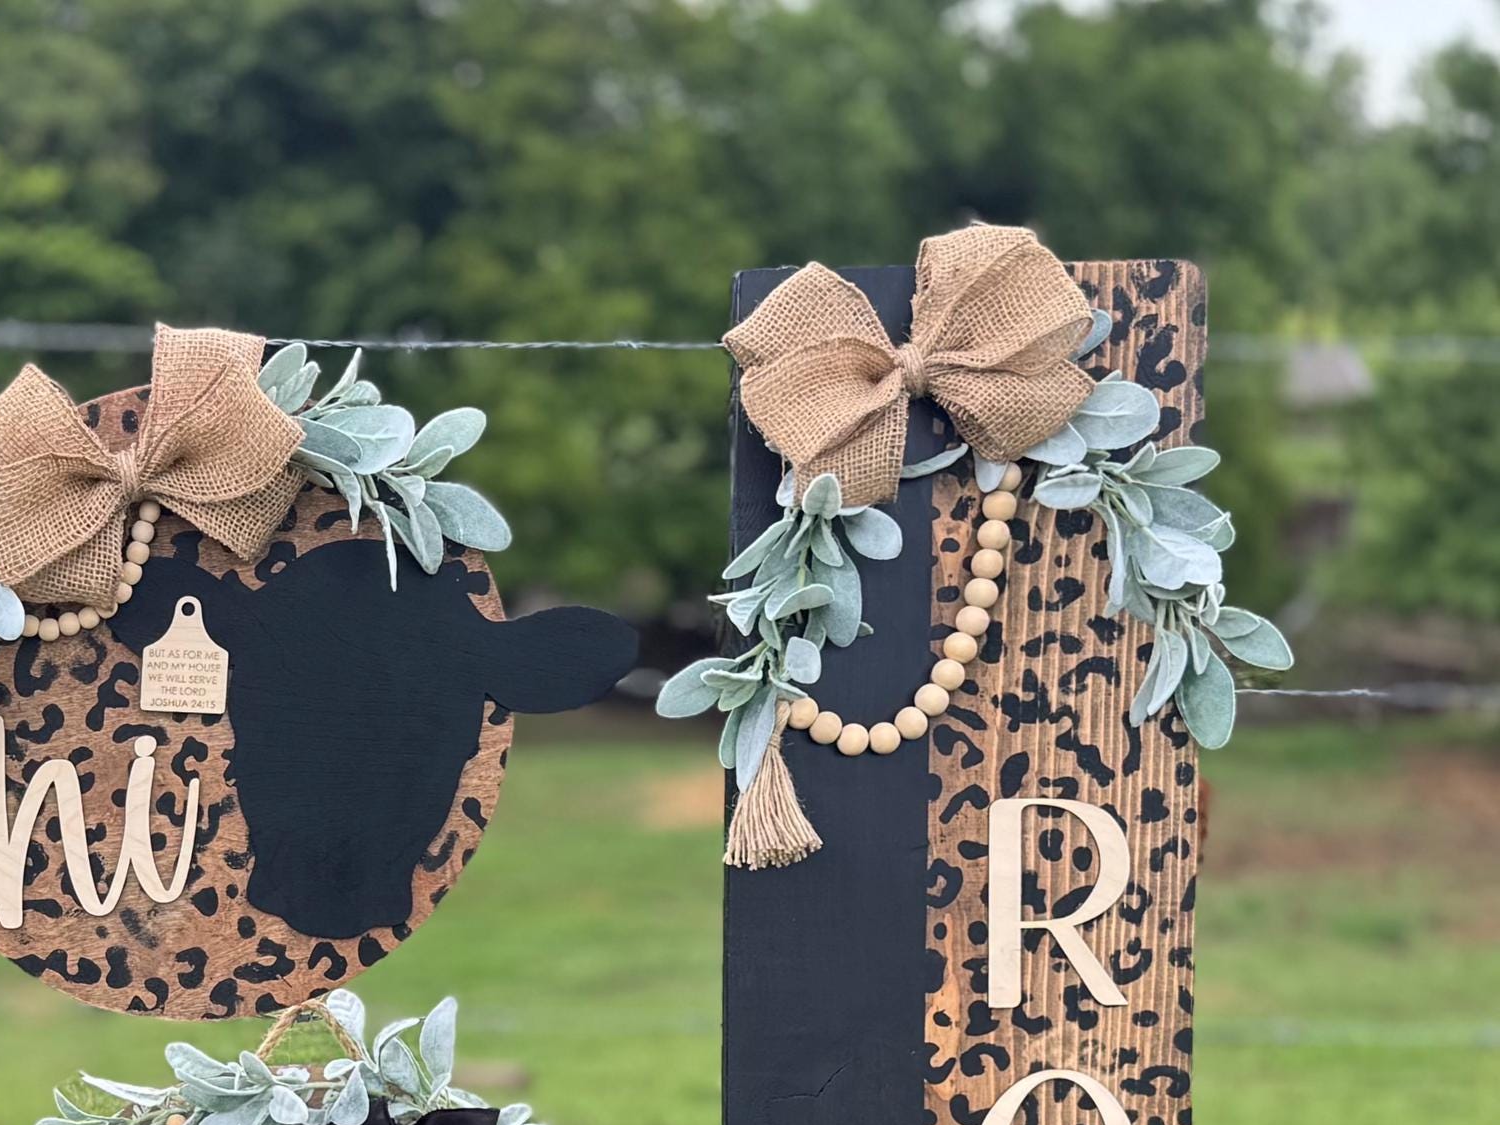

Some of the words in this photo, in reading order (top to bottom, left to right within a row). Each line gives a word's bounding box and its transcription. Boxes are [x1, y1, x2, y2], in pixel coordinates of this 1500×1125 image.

[149, 649, 165, 658] BUT
[167, 649, 180, 659] AS
[183, 650, 202, 660] FOR
[205, 651, 220, 661] ME
[147, 661, 168, 670] AND
[171, 663, 185, 671] MY
[188, 663, 221, 673] HOUSE
[148, 673, 163, 682] WE
[165, 674, 188, 684] WILL
[189, 675, 218, 685] SERVE
[161, 685, 178, 696] THE
[179, 687, 206, 696] LORD
[150, 698, 188, 707] JOSHUA
[191, 699, 216, 708] 24:15
